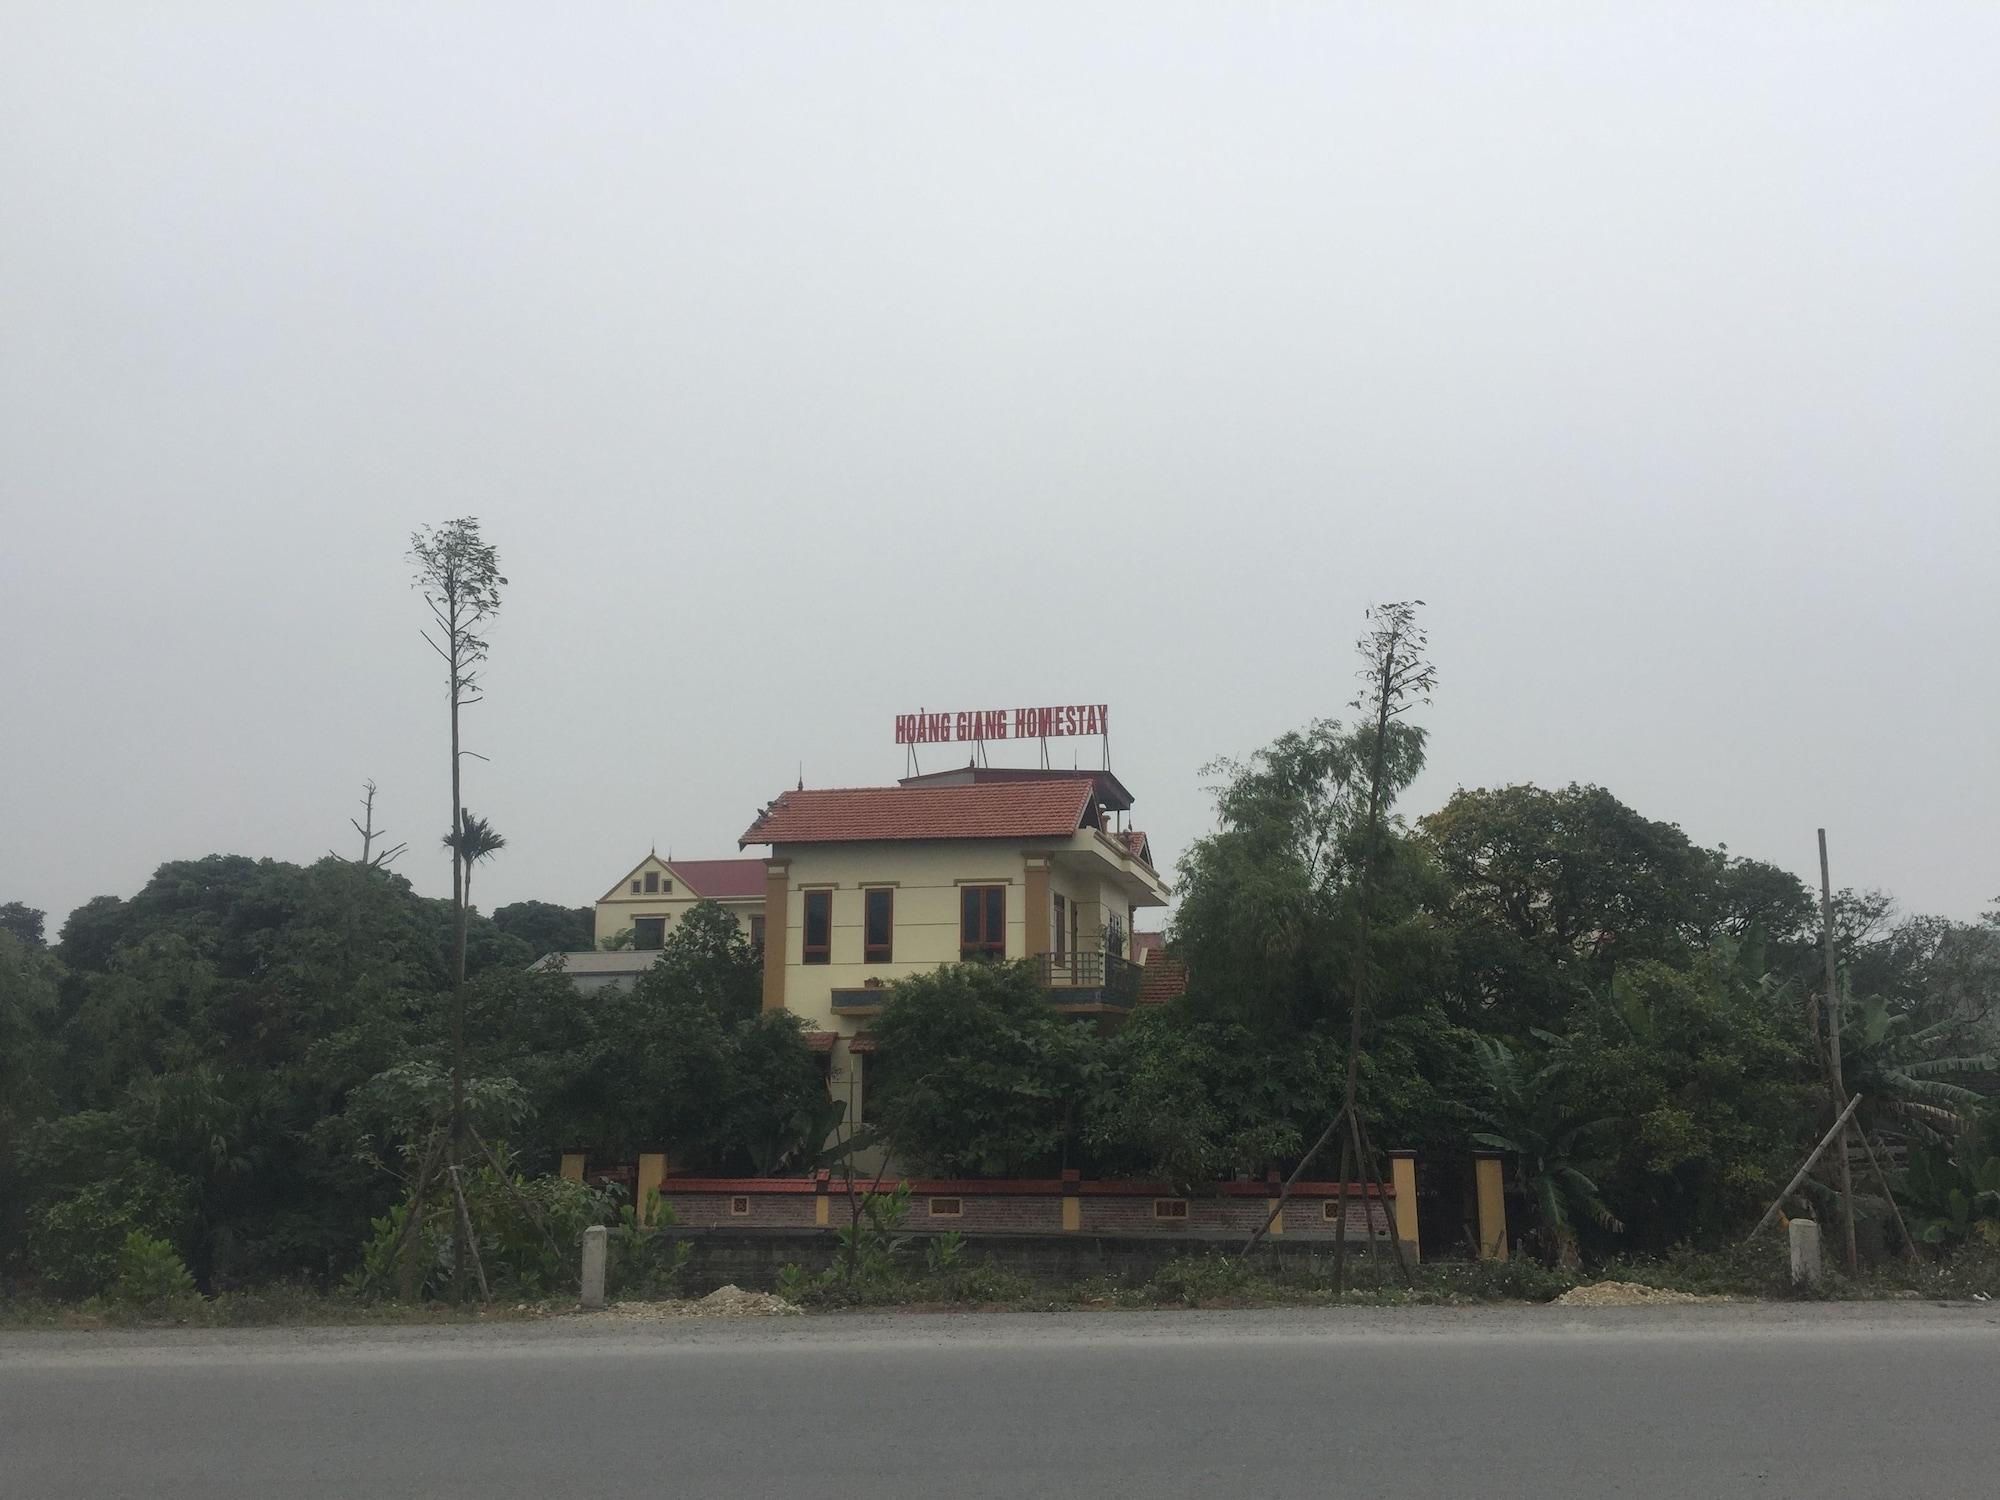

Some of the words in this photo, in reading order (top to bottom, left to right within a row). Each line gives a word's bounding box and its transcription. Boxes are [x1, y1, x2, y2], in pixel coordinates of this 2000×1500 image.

[896, 707, 951, 743] HOÀNG
[956, 709, 1007, 741] GIANG
[1015, 704, 1108, 738] HOMESTAY
